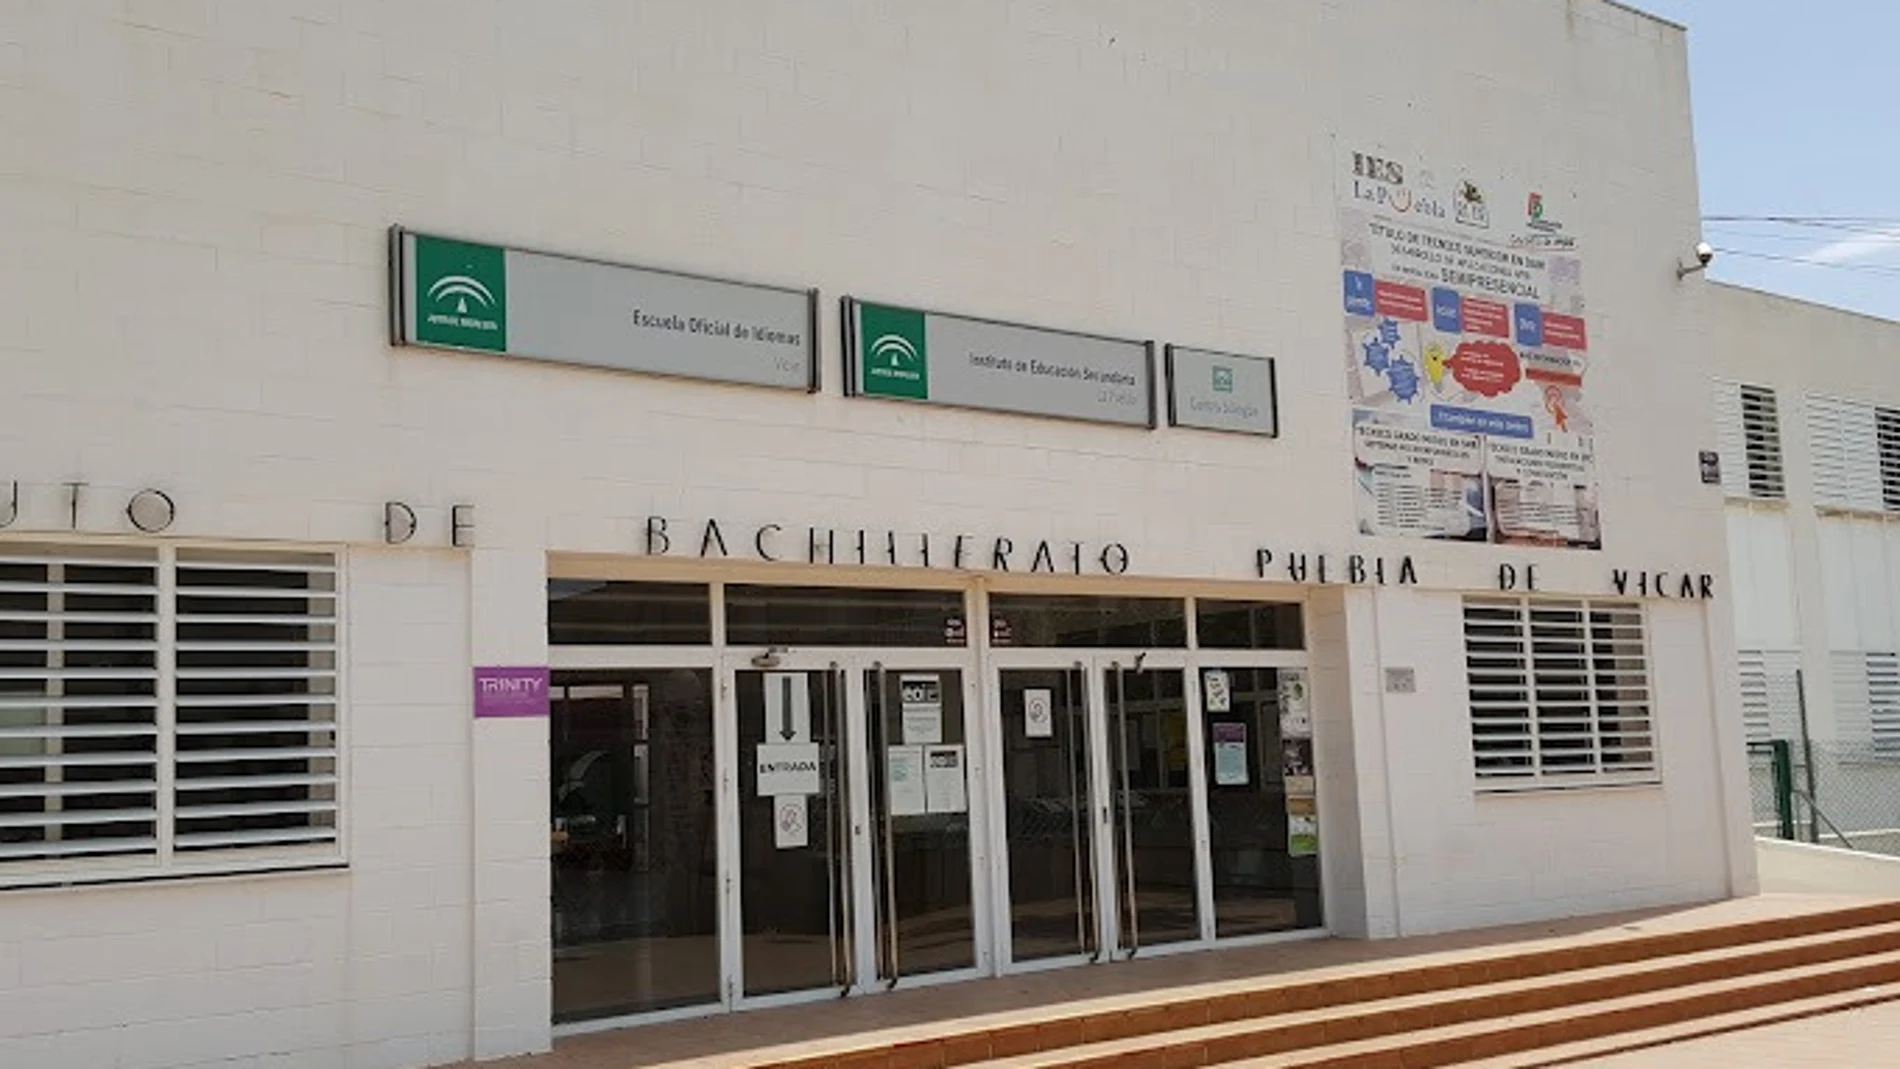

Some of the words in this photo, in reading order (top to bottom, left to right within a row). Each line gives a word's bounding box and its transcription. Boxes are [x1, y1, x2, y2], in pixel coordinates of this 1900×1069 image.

[1352, 151, 1403, 185] IES
[633, 308, 685, 333] Escuela
[688, 316, 731, 338] Oficial
[733, 323, 750, 339] de
[751, 325, 801, 346] Idiomas
[969, 351, 1013, 371] Instituto
[1014, 360, 1028, 373] de
[384, 501, 475, 547] DE
[1498, 563, 1541, 592] DE
[1613, 568, 1716, 600] VICAR
[478, 677, 543, 693] TRINITY
[760, 760, 817, 774] ENTRADA
